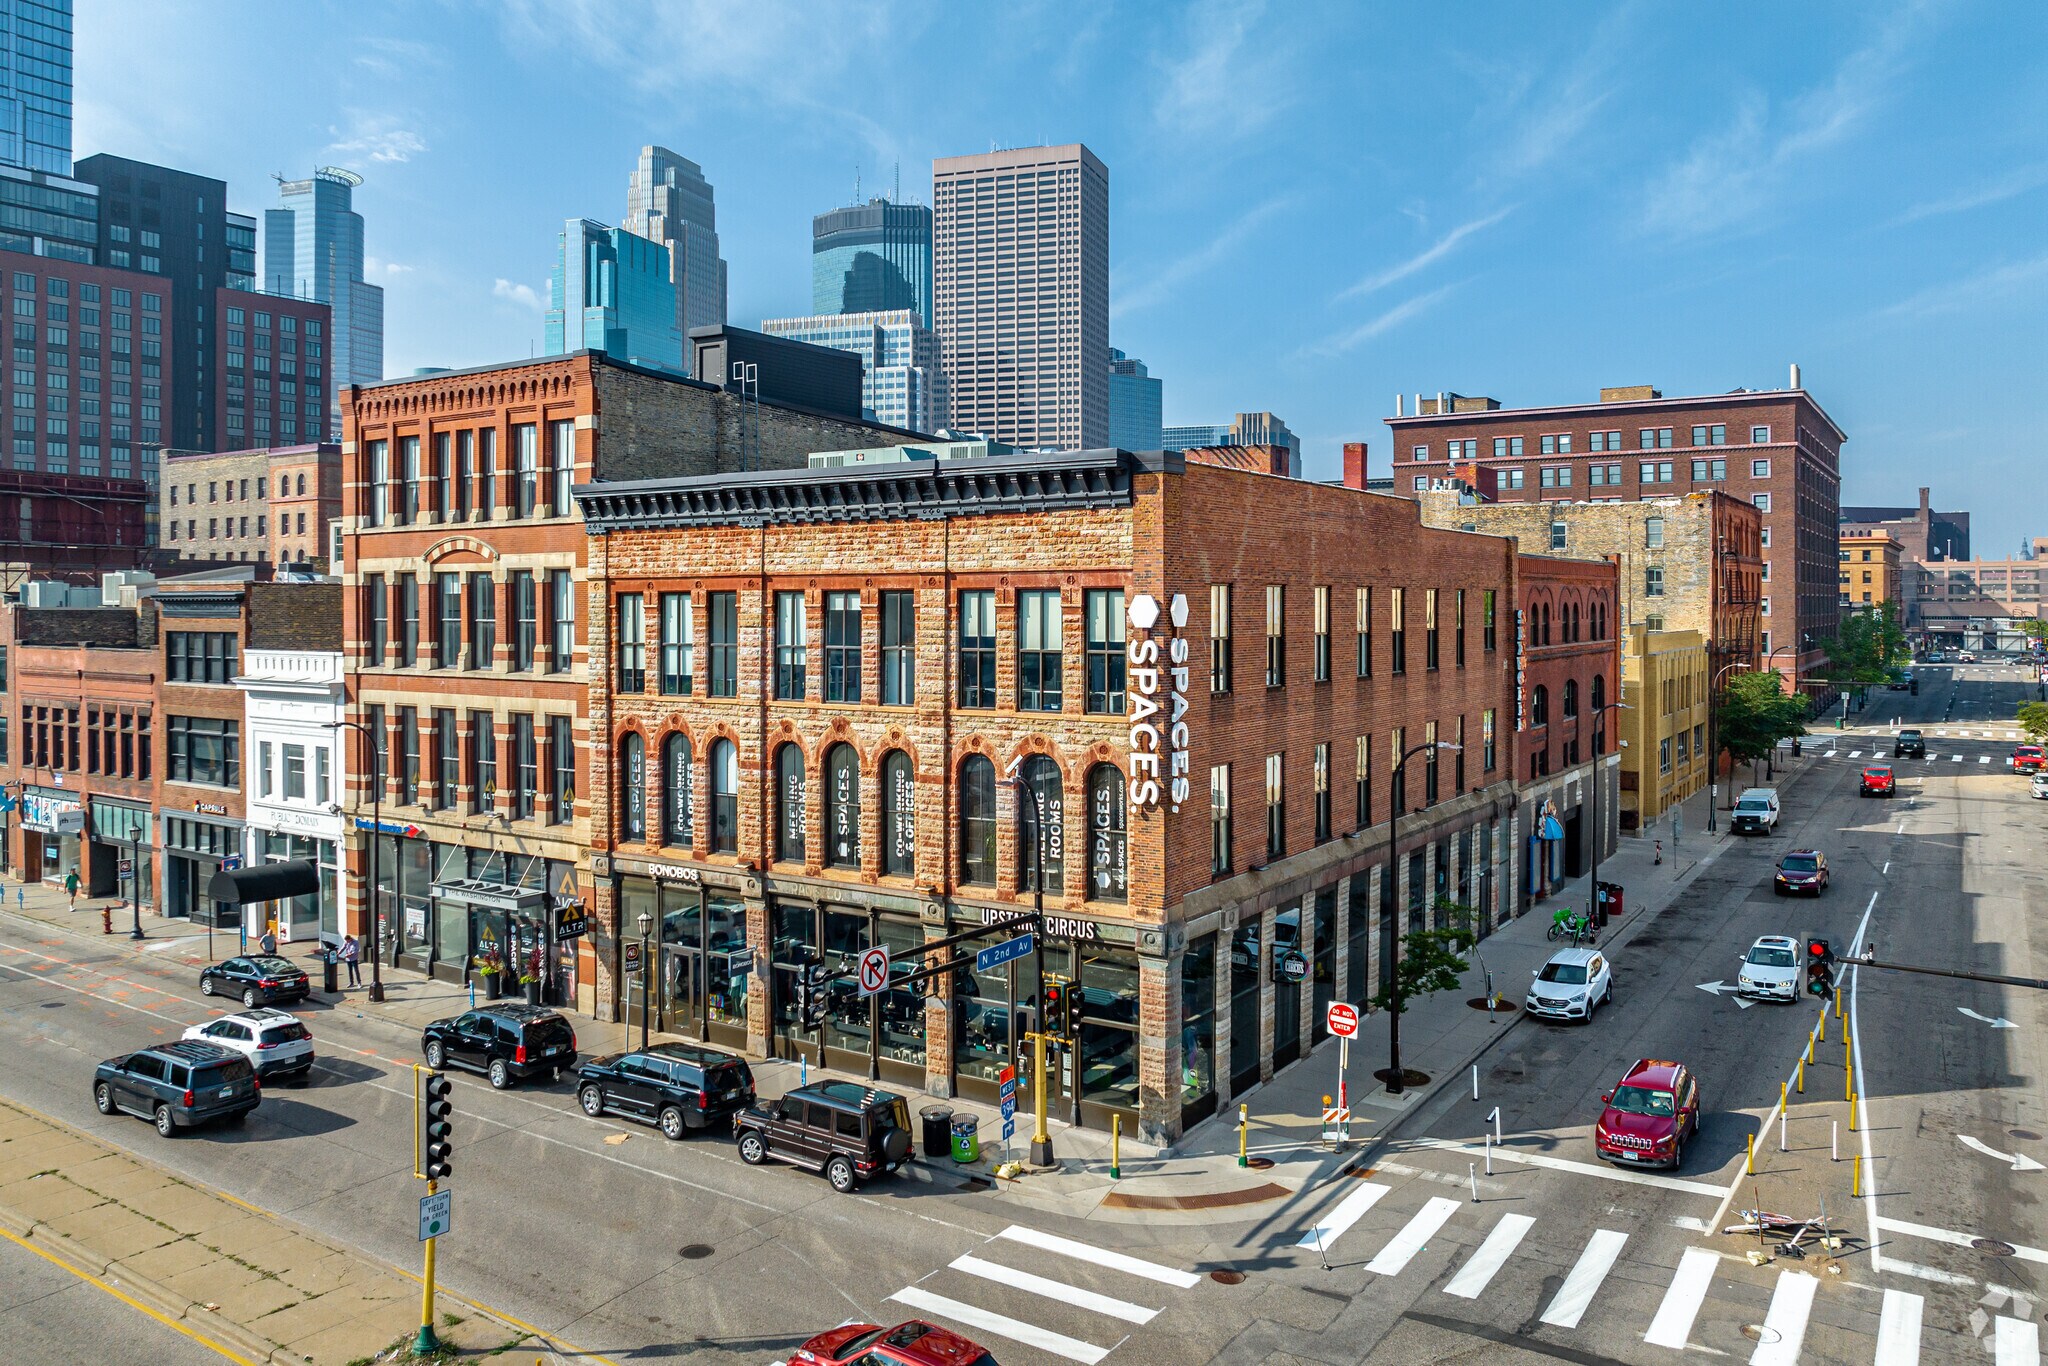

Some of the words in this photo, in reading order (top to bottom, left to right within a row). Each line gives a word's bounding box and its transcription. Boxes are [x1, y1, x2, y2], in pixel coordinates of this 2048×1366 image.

[1129, 638, 1160, 814] SPACES.
[1170, 637, 1189, 814] SPACES.
[631, 750, 641, 813] SPACES.
[677, 751, 685, 831] CO-WORKING
[200, 803, 225, 813] CAPSULE
[788, 774, 798, 840] MEETING
[798, 782, 806, 834] ROOMS
[838, 765, 850, 835] SPACES.
[905, 780, 914, 839] OFFICES
[270, 811, 291, 823] PUBLIC
[295, 814, 319, 827] DOMAIN
[896, 769, 905, 858] CO-WORKING
[1097, 786, 1111, 865] SPACES.
[1050, 799, 1061, 859] ROOMS
[648, 863, 698, 881] BONOBOS
[460, 890, 501, 904] WASHINGTON
[559, 921, 585, 935] ALTR
[981, 908, 1037, 932] UPST
[1046, 916, 1096, 939] CIRCUS
[982, 954, 988, 966] N
[994, 946, 1010, 961] 2nd
[1018, 942, 1028, 952] Av
[1332, 1007, 1340, 1015] DO
[1333, 1023, 1351, 1032] ENTER
[1002, 1083, 1013, 1095] WEST
[1002, 1100, 1015, 1117] 394
[422, 1198, 434, 1206] LEFT
[427, 1202, 444, 1213] YIELD
[432, 1210, 448, 1219] GREEN
